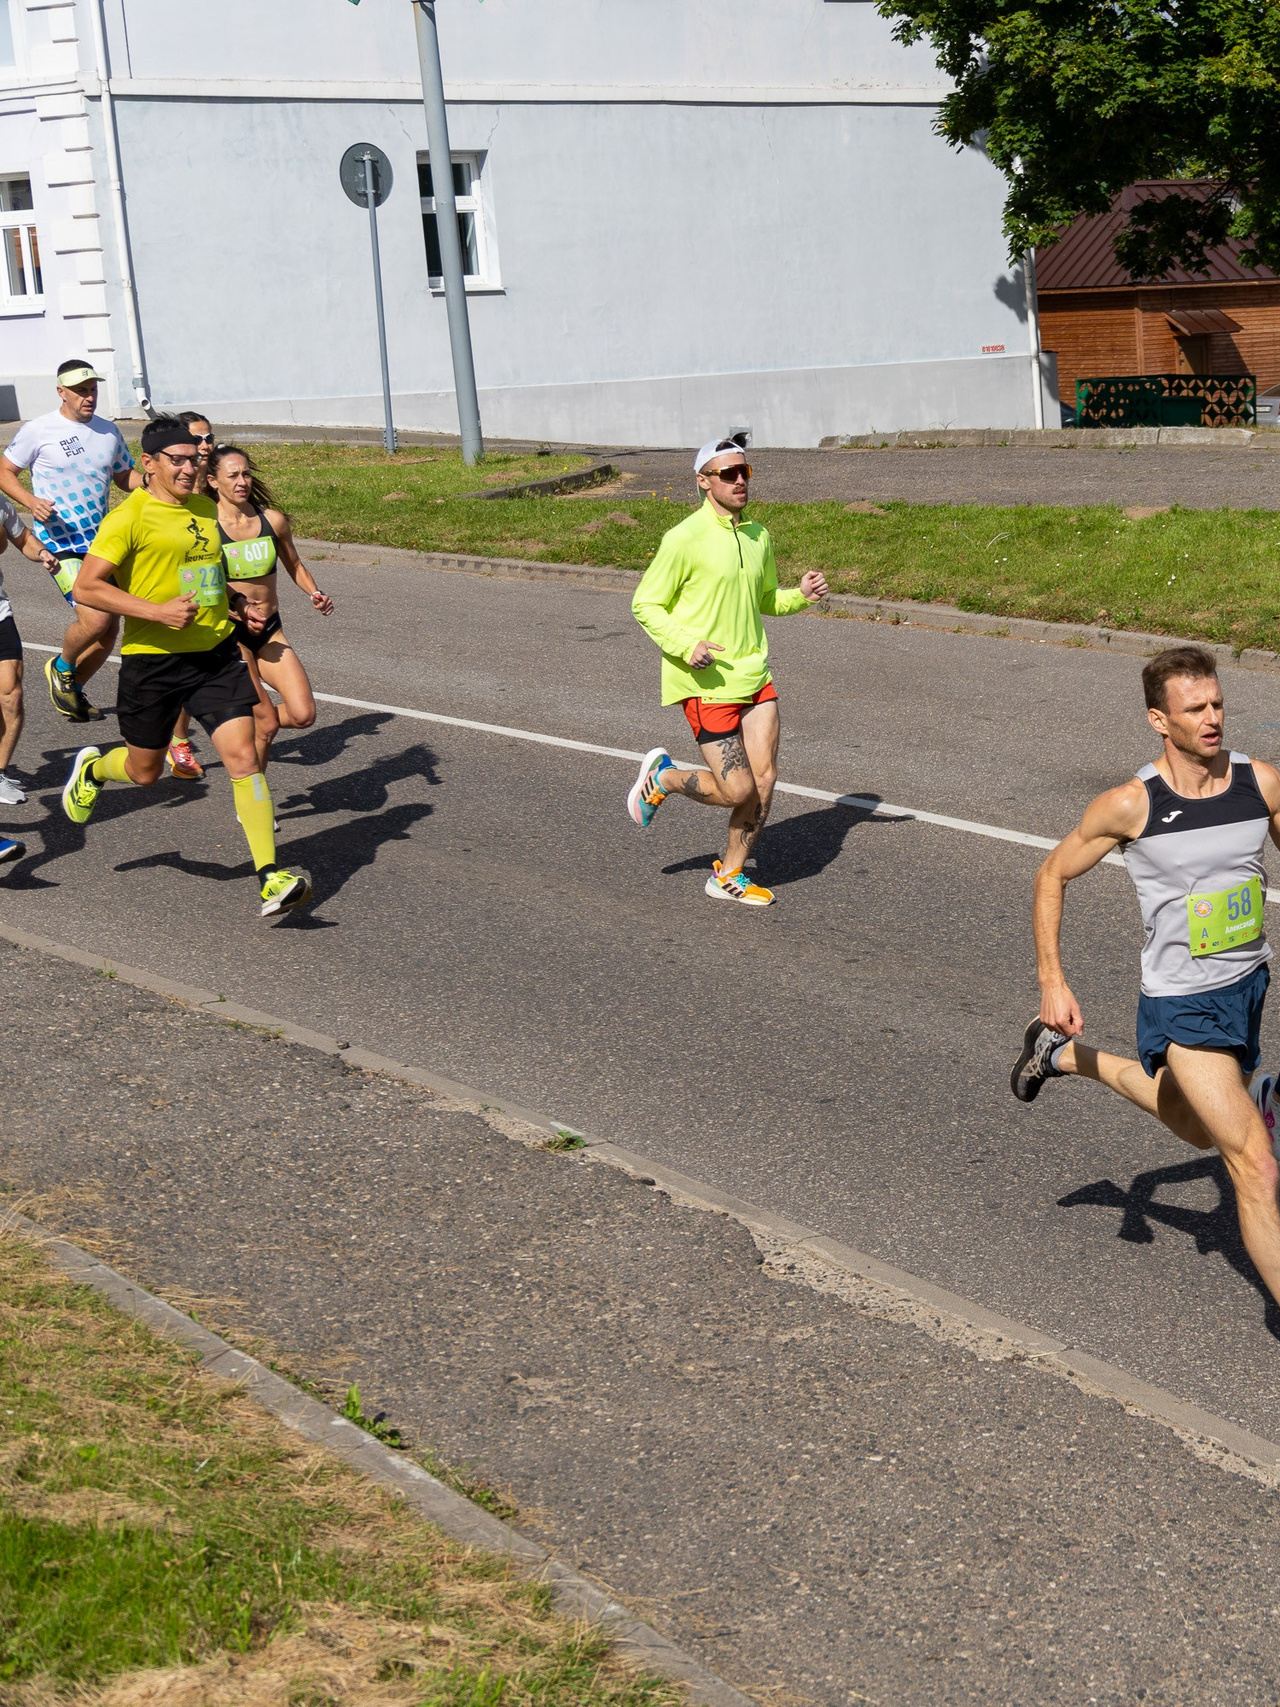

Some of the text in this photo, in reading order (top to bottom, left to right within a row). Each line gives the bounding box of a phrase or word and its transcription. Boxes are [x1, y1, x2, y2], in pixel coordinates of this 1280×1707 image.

[59, 435, 80, 446] RUN
[65, 446, 86, 458] FUN
[244, 540, 269, 562] 607
[1227, 887, 1252, 921] 58
[1201, 927, 1209, 939] A
